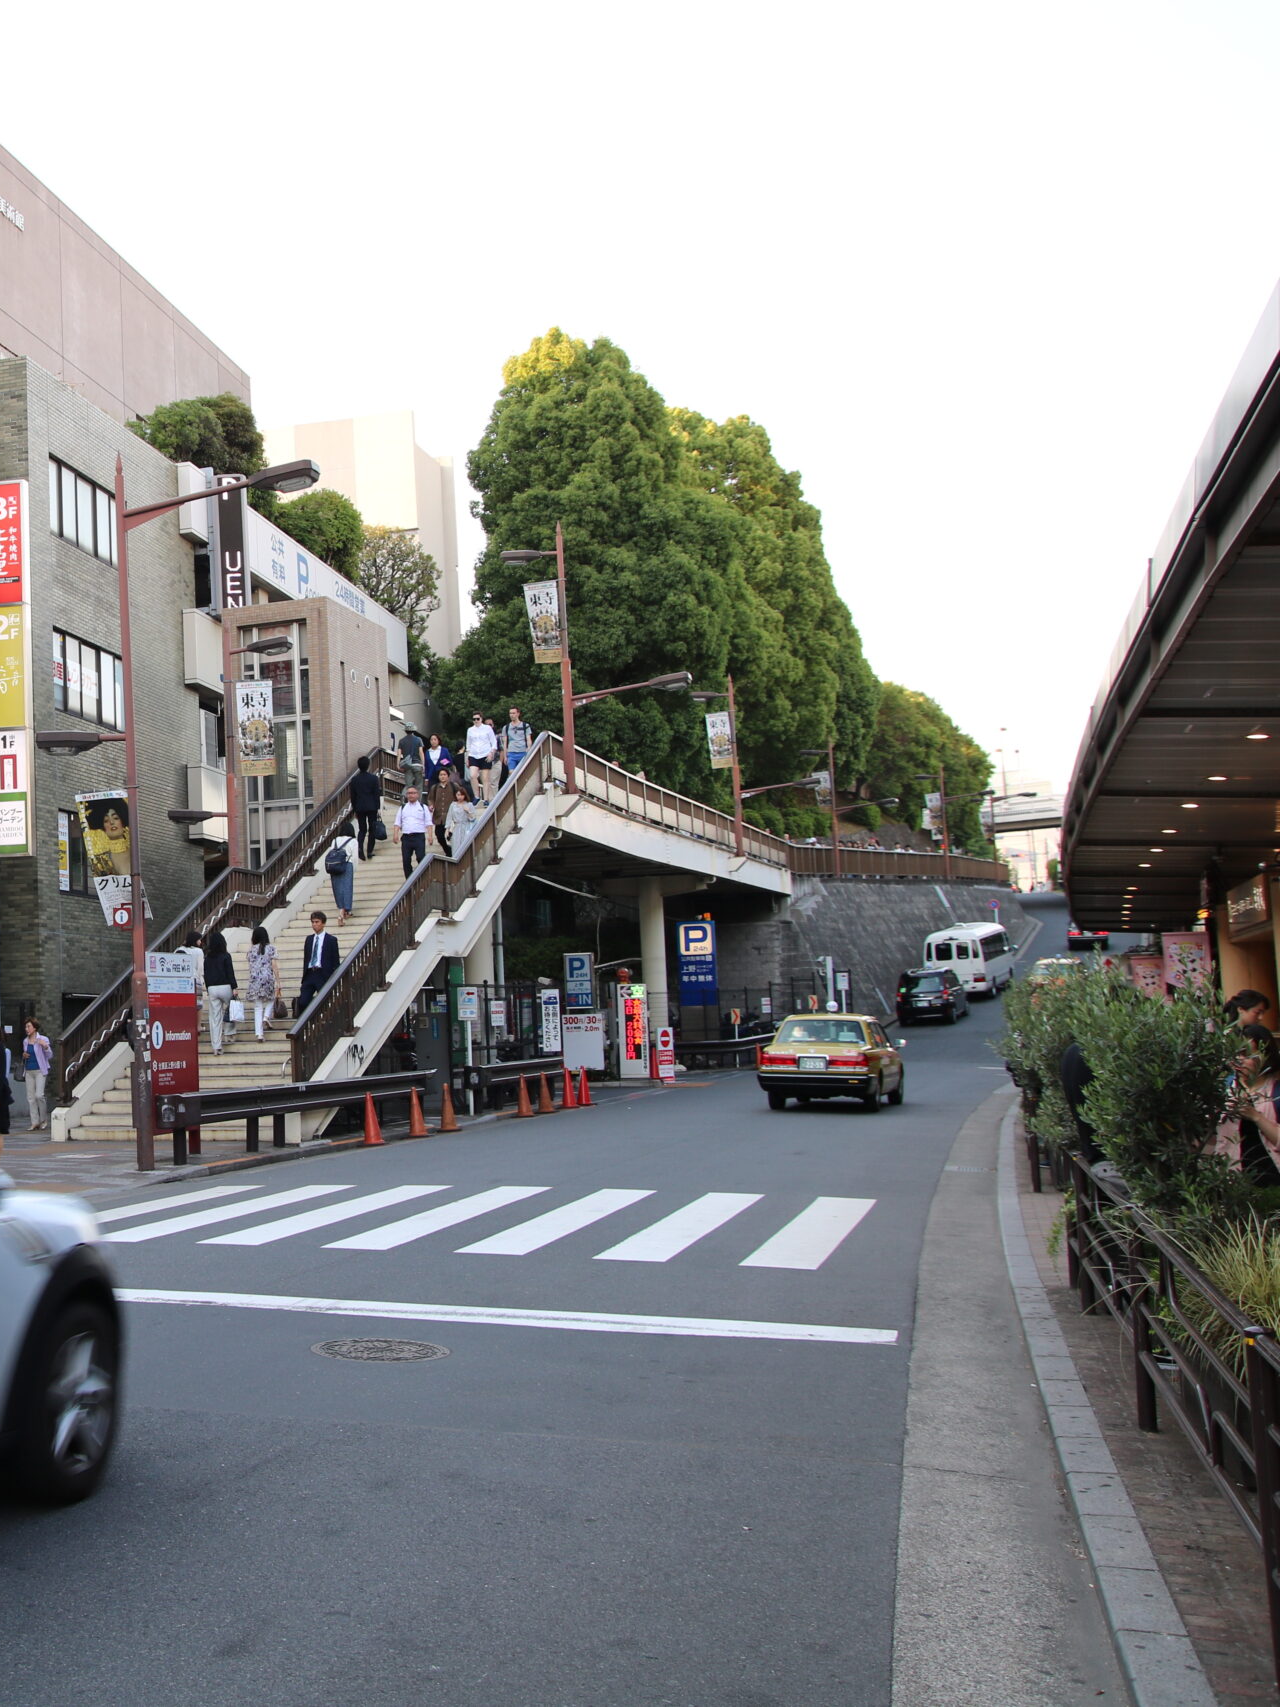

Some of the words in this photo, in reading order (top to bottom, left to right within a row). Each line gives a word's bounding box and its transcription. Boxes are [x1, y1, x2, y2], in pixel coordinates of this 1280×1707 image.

[297, 551, 309, 594] P
[242, 692, 269, 708] 東寺
[684, 926, 708, 951] P
[568, 957, 585, 978] P
[579, 995, 591, 1005] IN
[165, 1031, 191, 1041] Information
